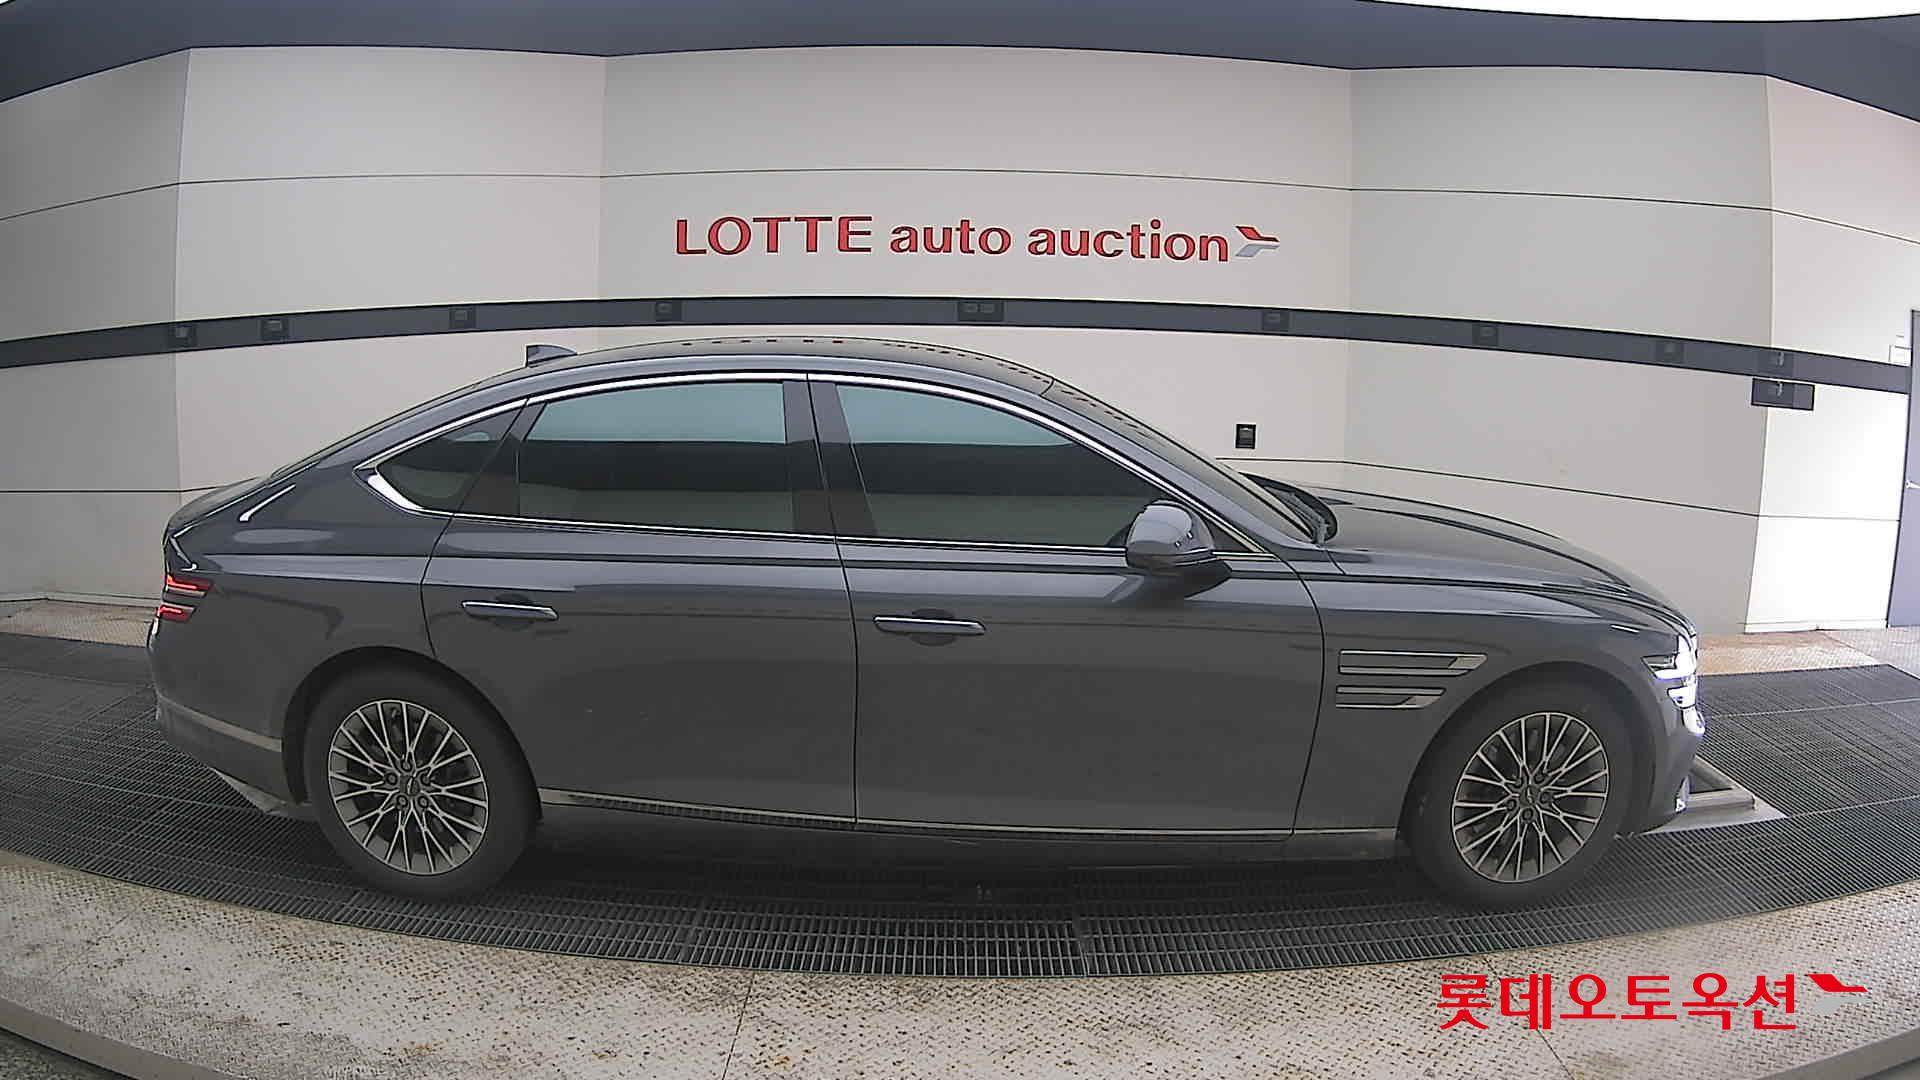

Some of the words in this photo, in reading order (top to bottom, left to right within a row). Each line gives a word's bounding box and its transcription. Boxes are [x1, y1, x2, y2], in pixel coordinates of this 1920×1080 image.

[676, 216, 872, 255] LOTTE
[889, 219, 1012, 255] auto
[1027, 219, 1229, 262] auction
